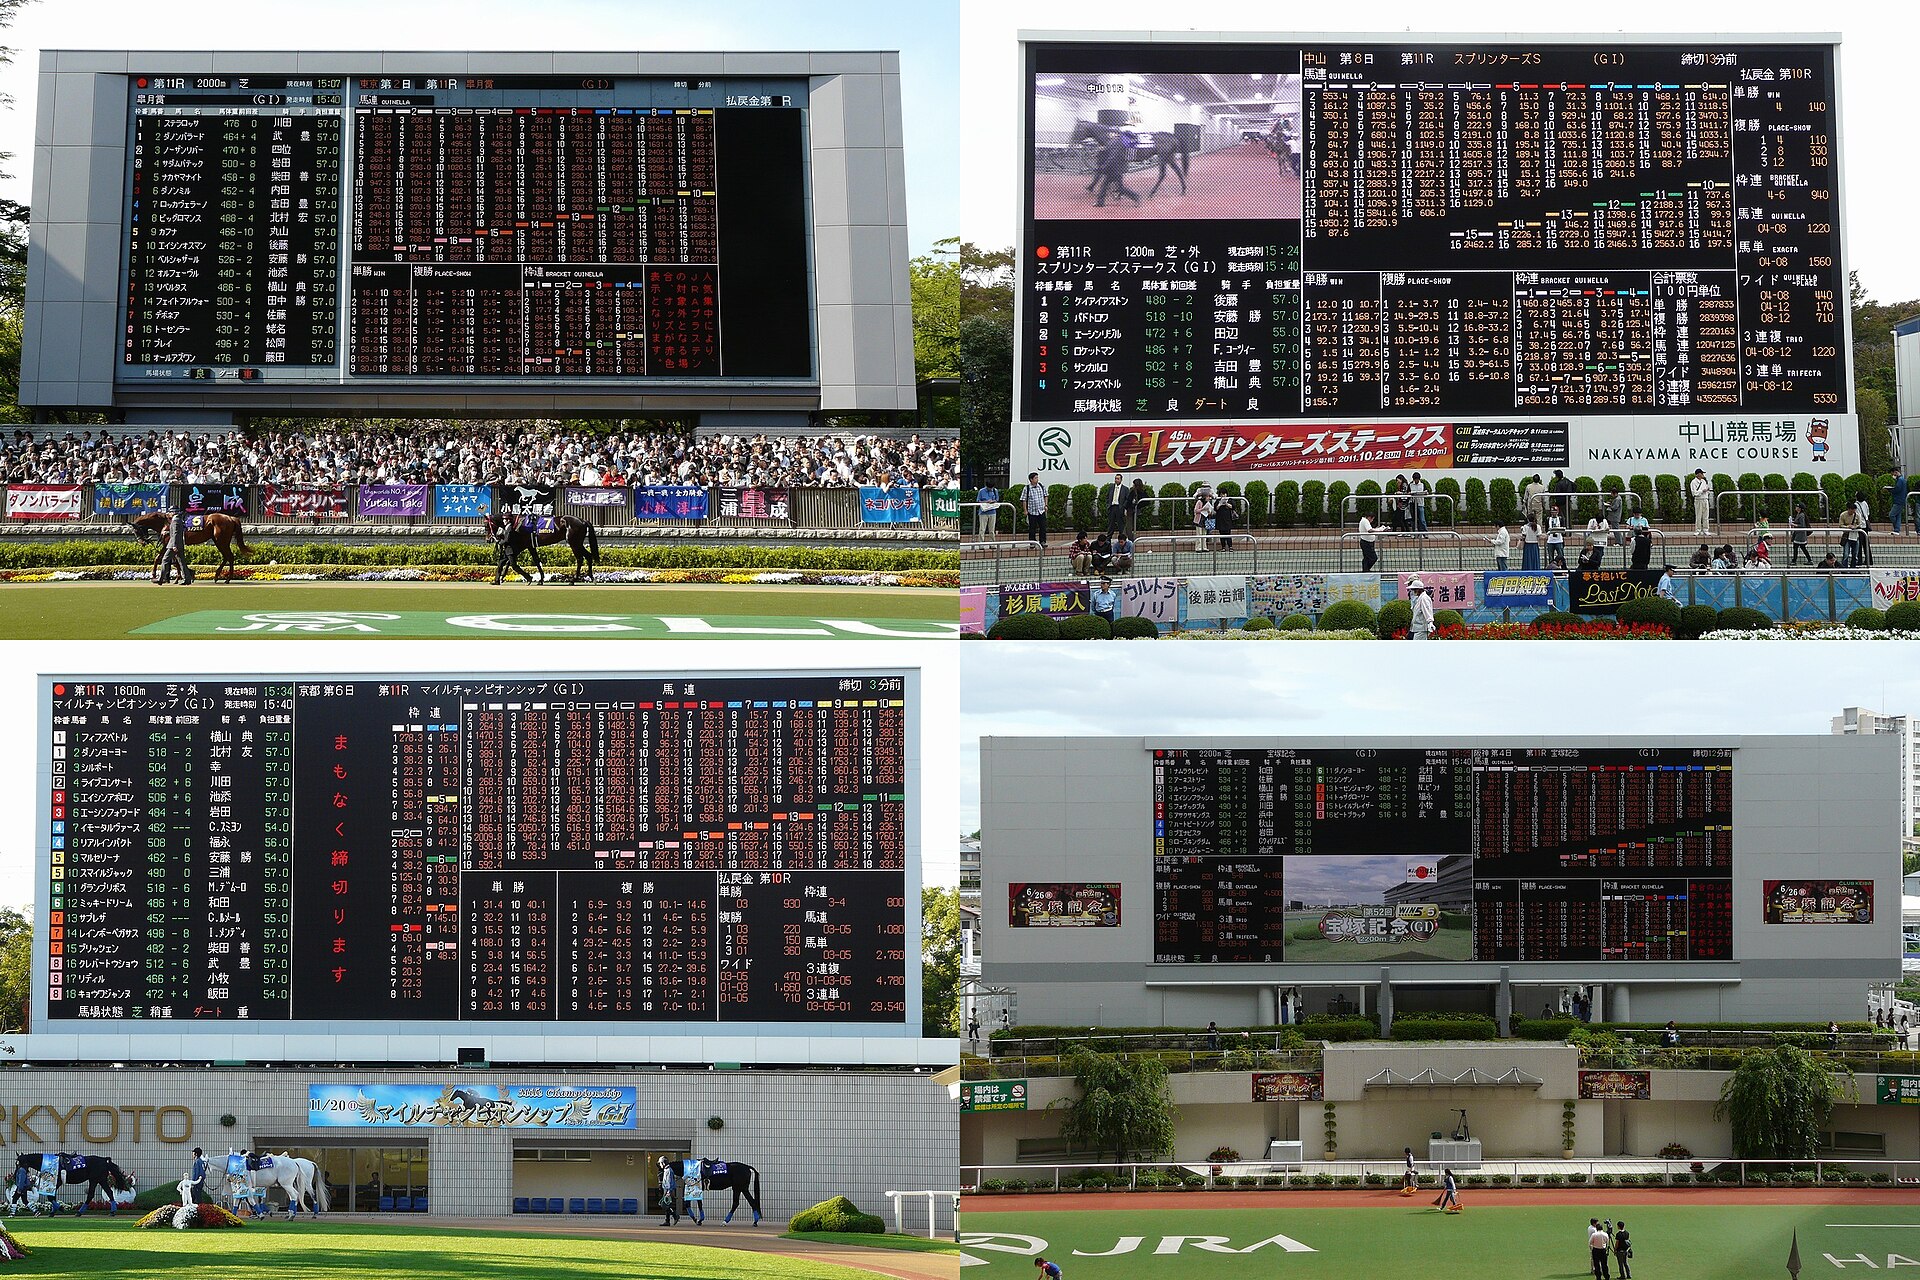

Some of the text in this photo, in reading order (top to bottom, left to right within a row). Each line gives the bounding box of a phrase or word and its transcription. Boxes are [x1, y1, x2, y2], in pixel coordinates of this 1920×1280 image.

[1304, 53, 1326, 64] 中山
[1340, 53, 1373, 65] 第8日
[1401, 53, 1433, 65] 第11R
[1455, 53, 1540, 64] スプリンターズS
[1741, 68, 1811, 80] 払戻金 第10R
[154, 79, 340, 88] 第11R 2000m 15:07
[360, 79, 378, 88] 東京
[381, 79, 410, 89] 第2日
[427, 79, 457, 89] 第11R
[317, 96, 340, 104] 15:40
[358, 94, 377, 106] 馬連
[274, 118, 291, 127] 川田
[1057, 246, 1091, 258] 第11R
[1125, 246, 1154, 257] 1200m
[1165, 245, 1200, 258] 芝・外
[1739, 241, 1764, 253] 馬単
[1759, 257, 1831, 266] 04-08 1560
[353, 266, 372, 276] 単勝
[414, 266, 433, 276] 複勝
[525, 267, 543, 276] 枠連
[1075, 294, 1238, 306] ケイアイアストン 後藤
[1214, 310, 1238, 322] 安藤
[1074, 346, 1114, 355] ロケットマン
[1074, 360, 1237, 372] サンカルロ 吉田
[1747, 381, 1792, 390] 04-08-12
[1814, 394, 1837, 403] 5330
[1073, 399, 1121, 412] 馬場状態
[1170, 431, 1191, 440] 45th
[1680, 421, 1797, 443] 中山競馬場
[1161, 426, 1446, 466] スプリンターズステークス
[1339, 451, 1383, 463] 2011.10.2
[1589, 447, 1798, 460] NAKAYAMA RACE COURSE
[1038, 459, 1069, 470] JRA
[9, 493, 79, 509] ダノンバラード
[364, 499, 422, 508] Yutaka Take
[442, 495, 478, 503] ナカヤマ
[544, 518, 552, 528] 7
[1123, 579, 1176, 601] ウルトラ
[1580, 583, 1620, 604] Last
[1189, 588, 1245, 604] 後藤浩輝
[1006, 593, 1085, 614] 杉原 誠人
[216, 623, 381, 631] JRA
[75, 685, 104, 696] 第11R
[115, 686, 145, 695] 1600m
[264, 687, 292, 695] 15:34
[299, 685, 320, 696] 京都
[324, 685, 353, 696] 第6日
[379, 685, 408, 696] 第11R
[264, 700, 292, 709] 15:40
[82, 746, 231, 757] ダノンヨーヨー 北村
[81, 776, 231, 787] ライブコンサート 川田
[80, 866, 230, 878] スマイルジャック 三浦
[718, 872, 790, 885] 払戻金 第10R
[80, 896, 229, 908] ミッキードリーム 和田
[78, 1006, 123, 1017] 馬場状態
[807, 1002, 850, 1011] 03-05-01
[1072, 1234, 1319, 1255] JRA
